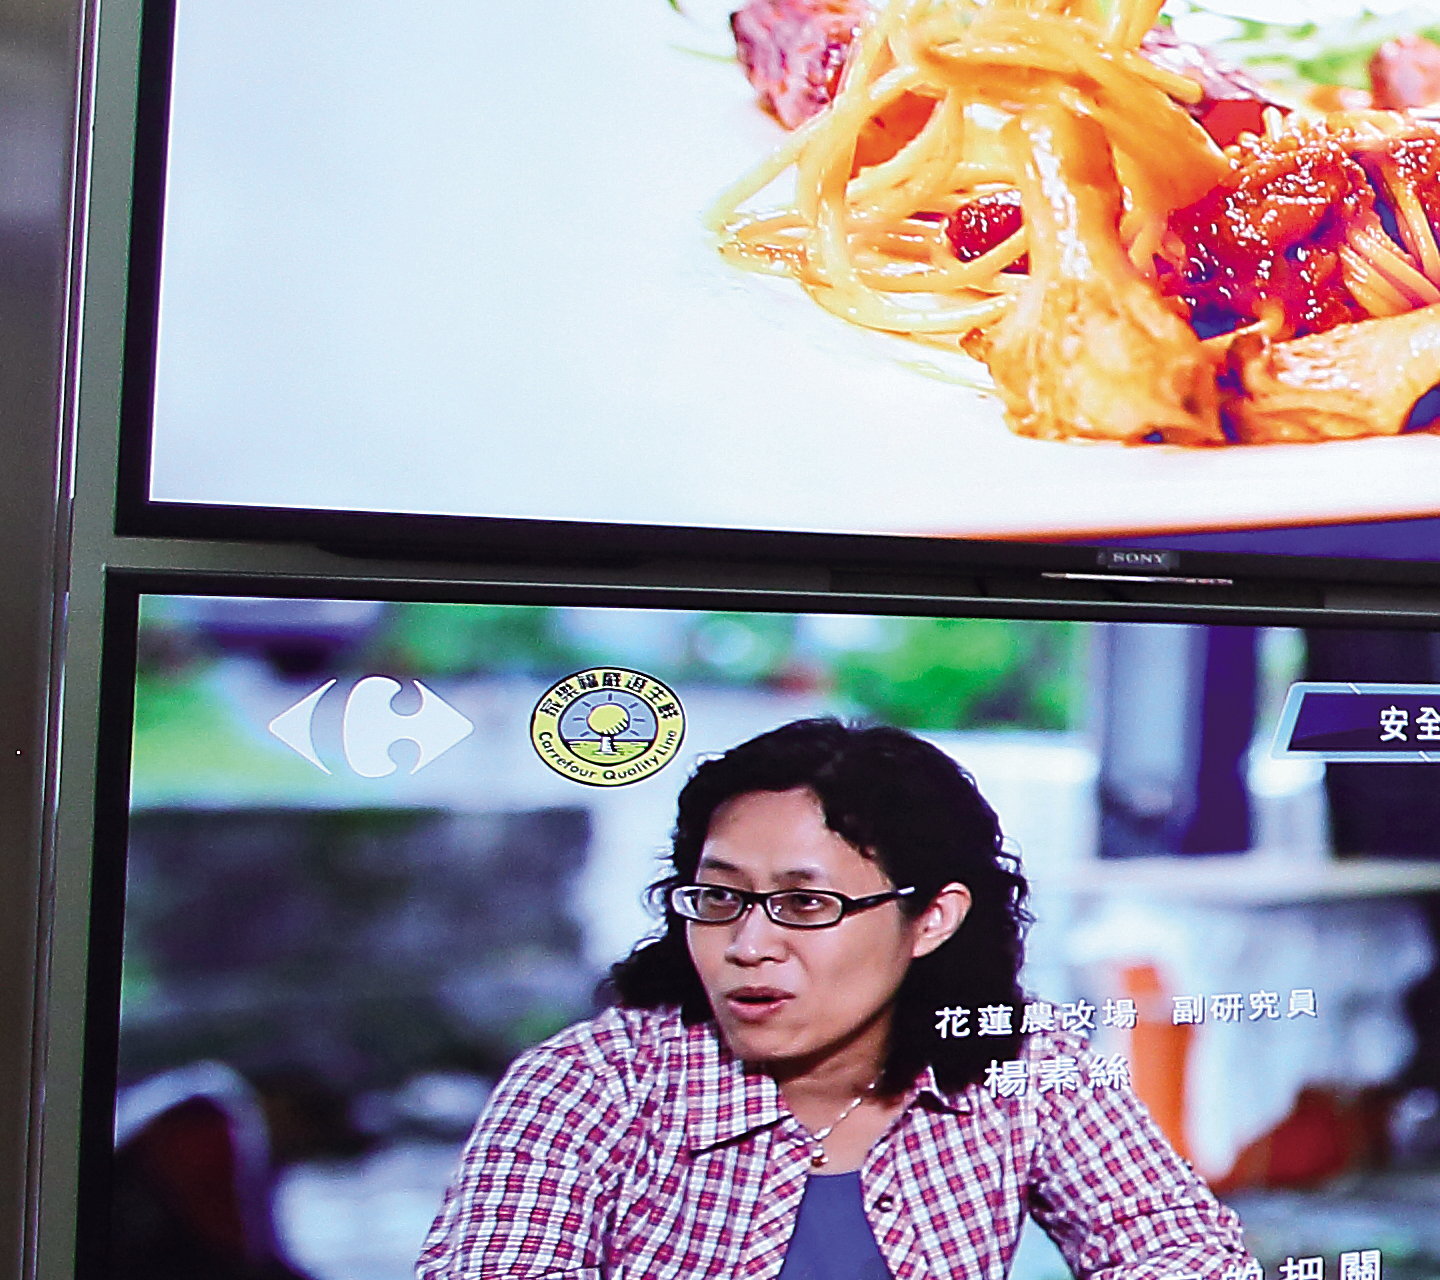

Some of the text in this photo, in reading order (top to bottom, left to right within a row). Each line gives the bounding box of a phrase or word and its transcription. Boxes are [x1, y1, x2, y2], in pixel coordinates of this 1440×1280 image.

[1113, 552, 1167, 564] SONY
[539, 729, 677, 780] Carrefour Quality Line
[933, 986, 1320, 1040] 花蓮農改場 副研究員
[983, 1053, 1134, 1099] 楊素絲
